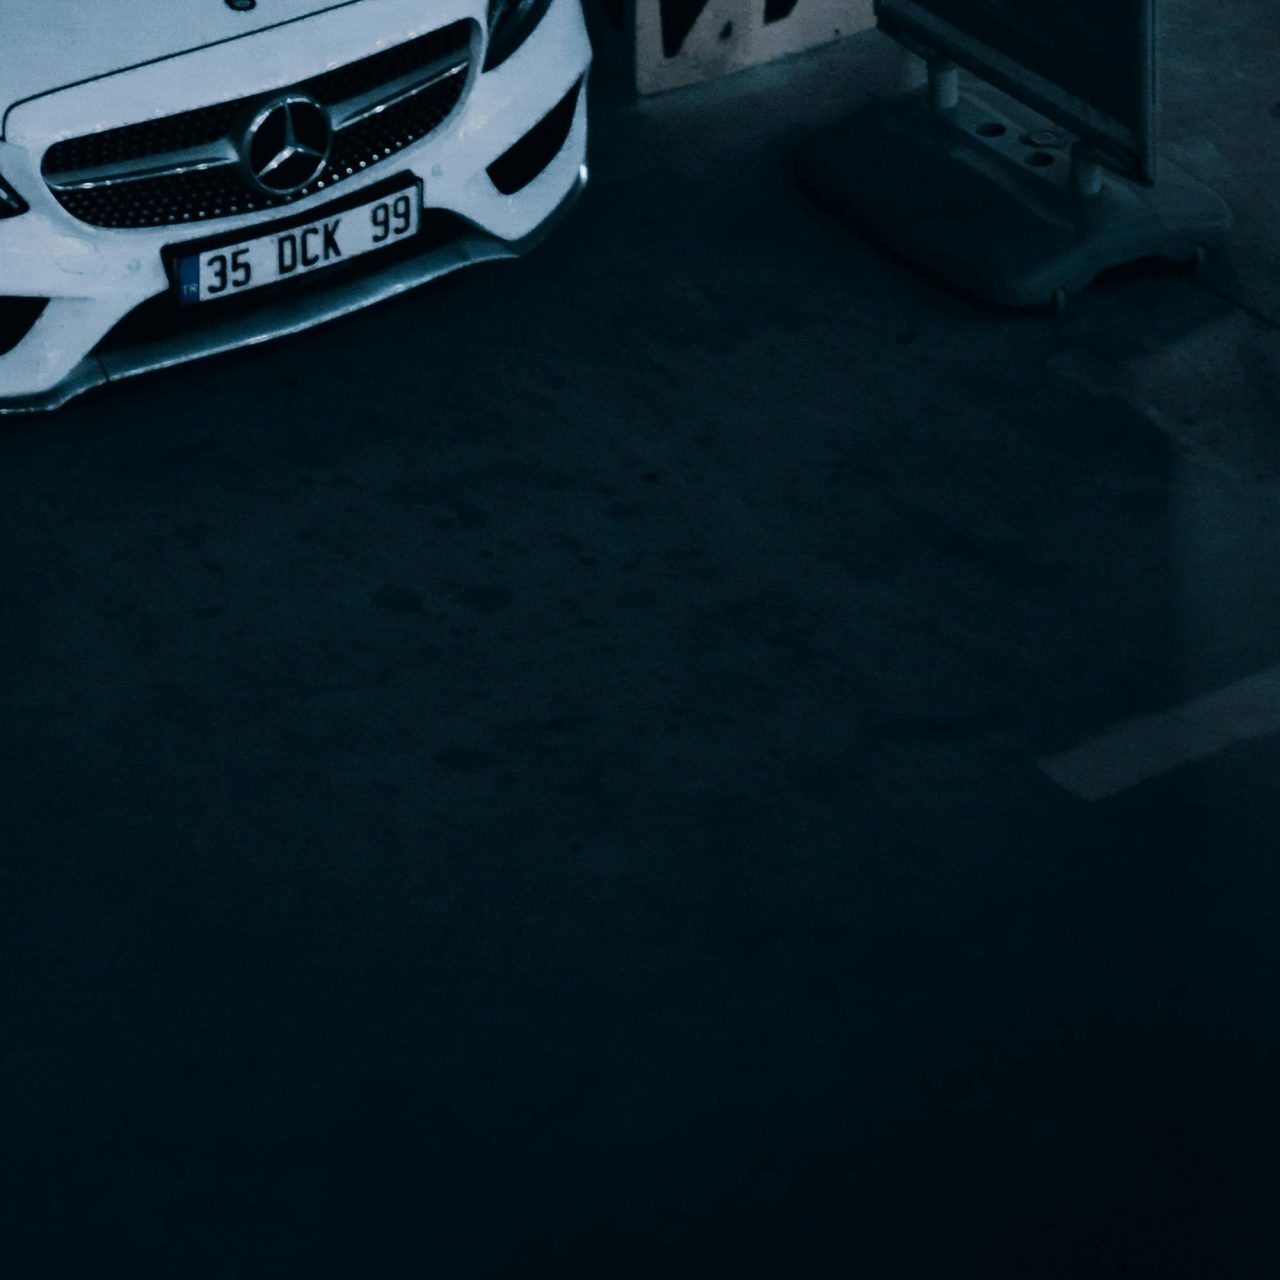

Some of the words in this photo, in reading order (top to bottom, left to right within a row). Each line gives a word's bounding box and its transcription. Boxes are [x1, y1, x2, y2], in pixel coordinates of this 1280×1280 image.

[207, 249, 250, 293] 35
[278, 220, 341, 274] DCK
[372, 195, 410, 242] 99
